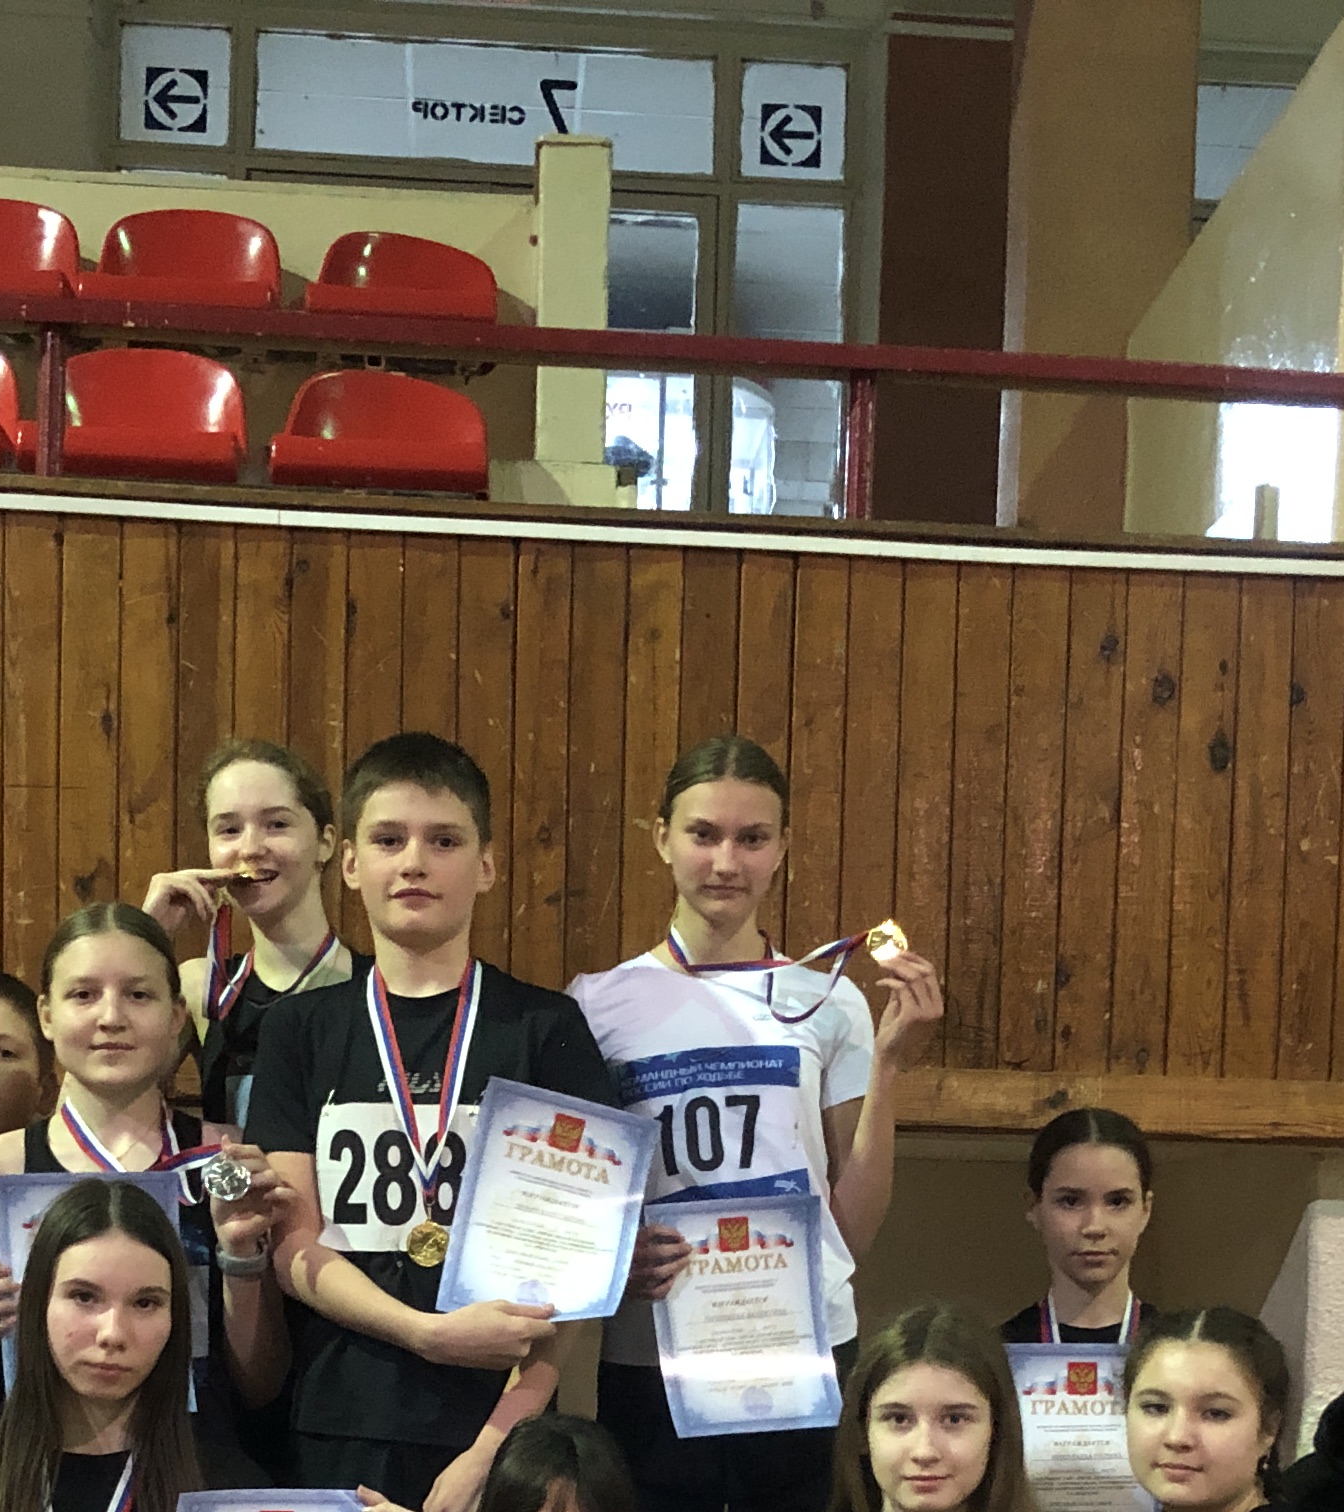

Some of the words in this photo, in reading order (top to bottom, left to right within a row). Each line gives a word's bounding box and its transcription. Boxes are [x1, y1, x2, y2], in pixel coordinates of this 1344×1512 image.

[675, 1076, 692, 1087] ПО
[696, 1070, 746, 1083] ХОДЬБЕ
[705, 1058, 784, 1071] ЧЕМПИОНАТ
[654, 1094, 761, 1177] 107
[328, 1128, 467, 1227] 288
[503, 1140, 611, 1186] ГРАМОТА
[683, 1252, 789, 1278] ГРАМОТА
